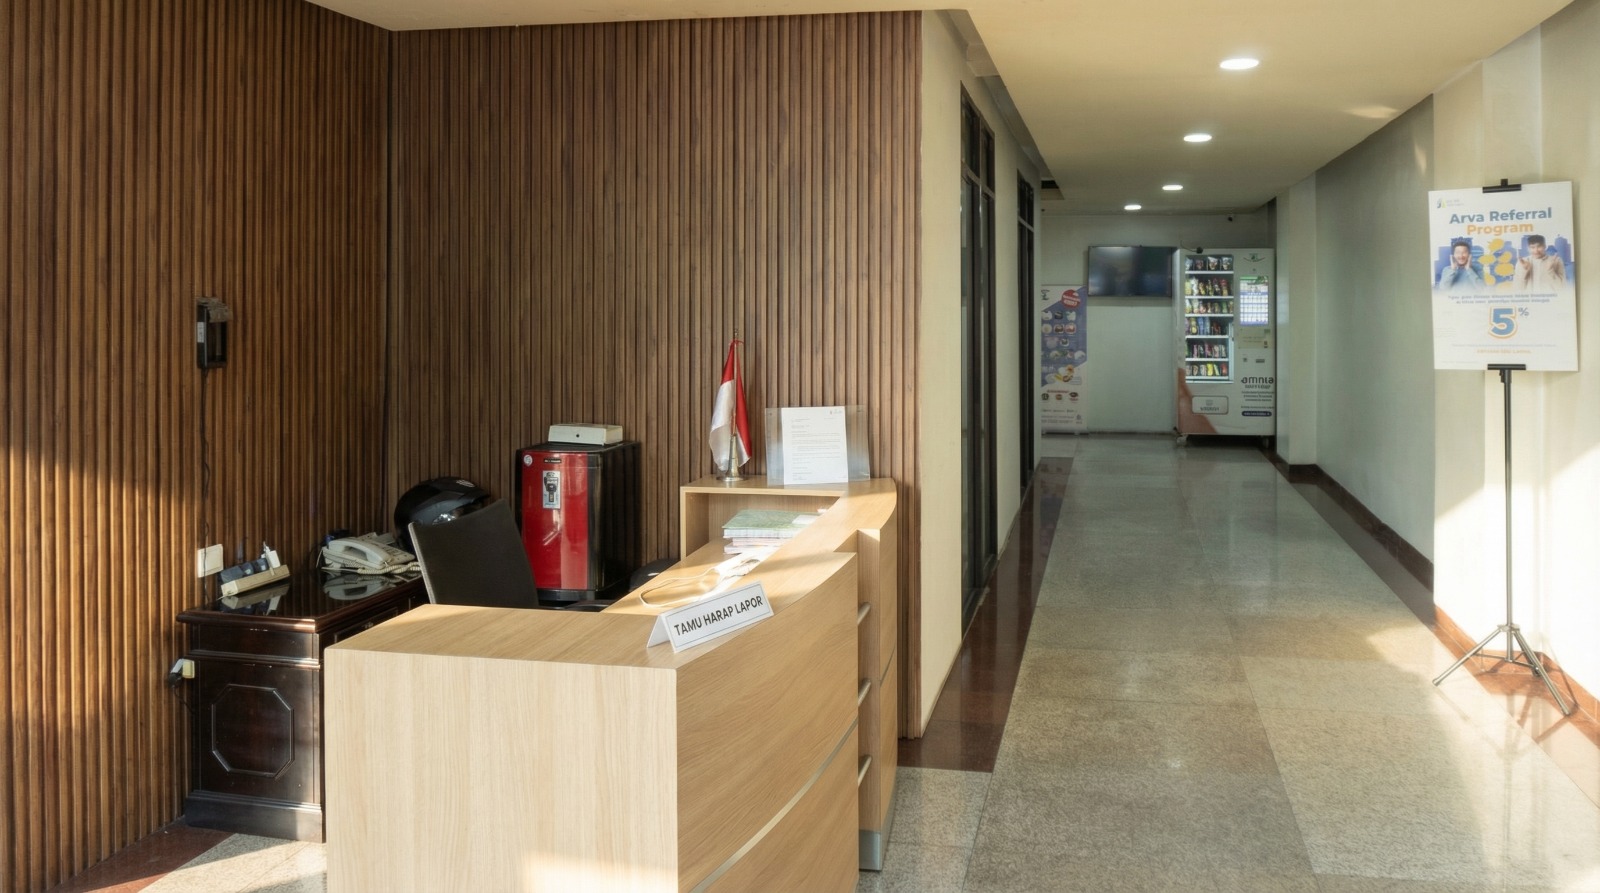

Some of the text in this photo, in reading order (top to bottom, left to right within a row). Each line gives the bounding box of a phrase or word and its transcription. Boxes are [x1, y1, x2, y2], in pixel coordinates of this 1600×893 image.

[1449, 207, 1552, 224] Arva Referral
[1466, 223, 1534, 236] Program
[674, 595, 763, 636] TAMU HARAP LAPOR
